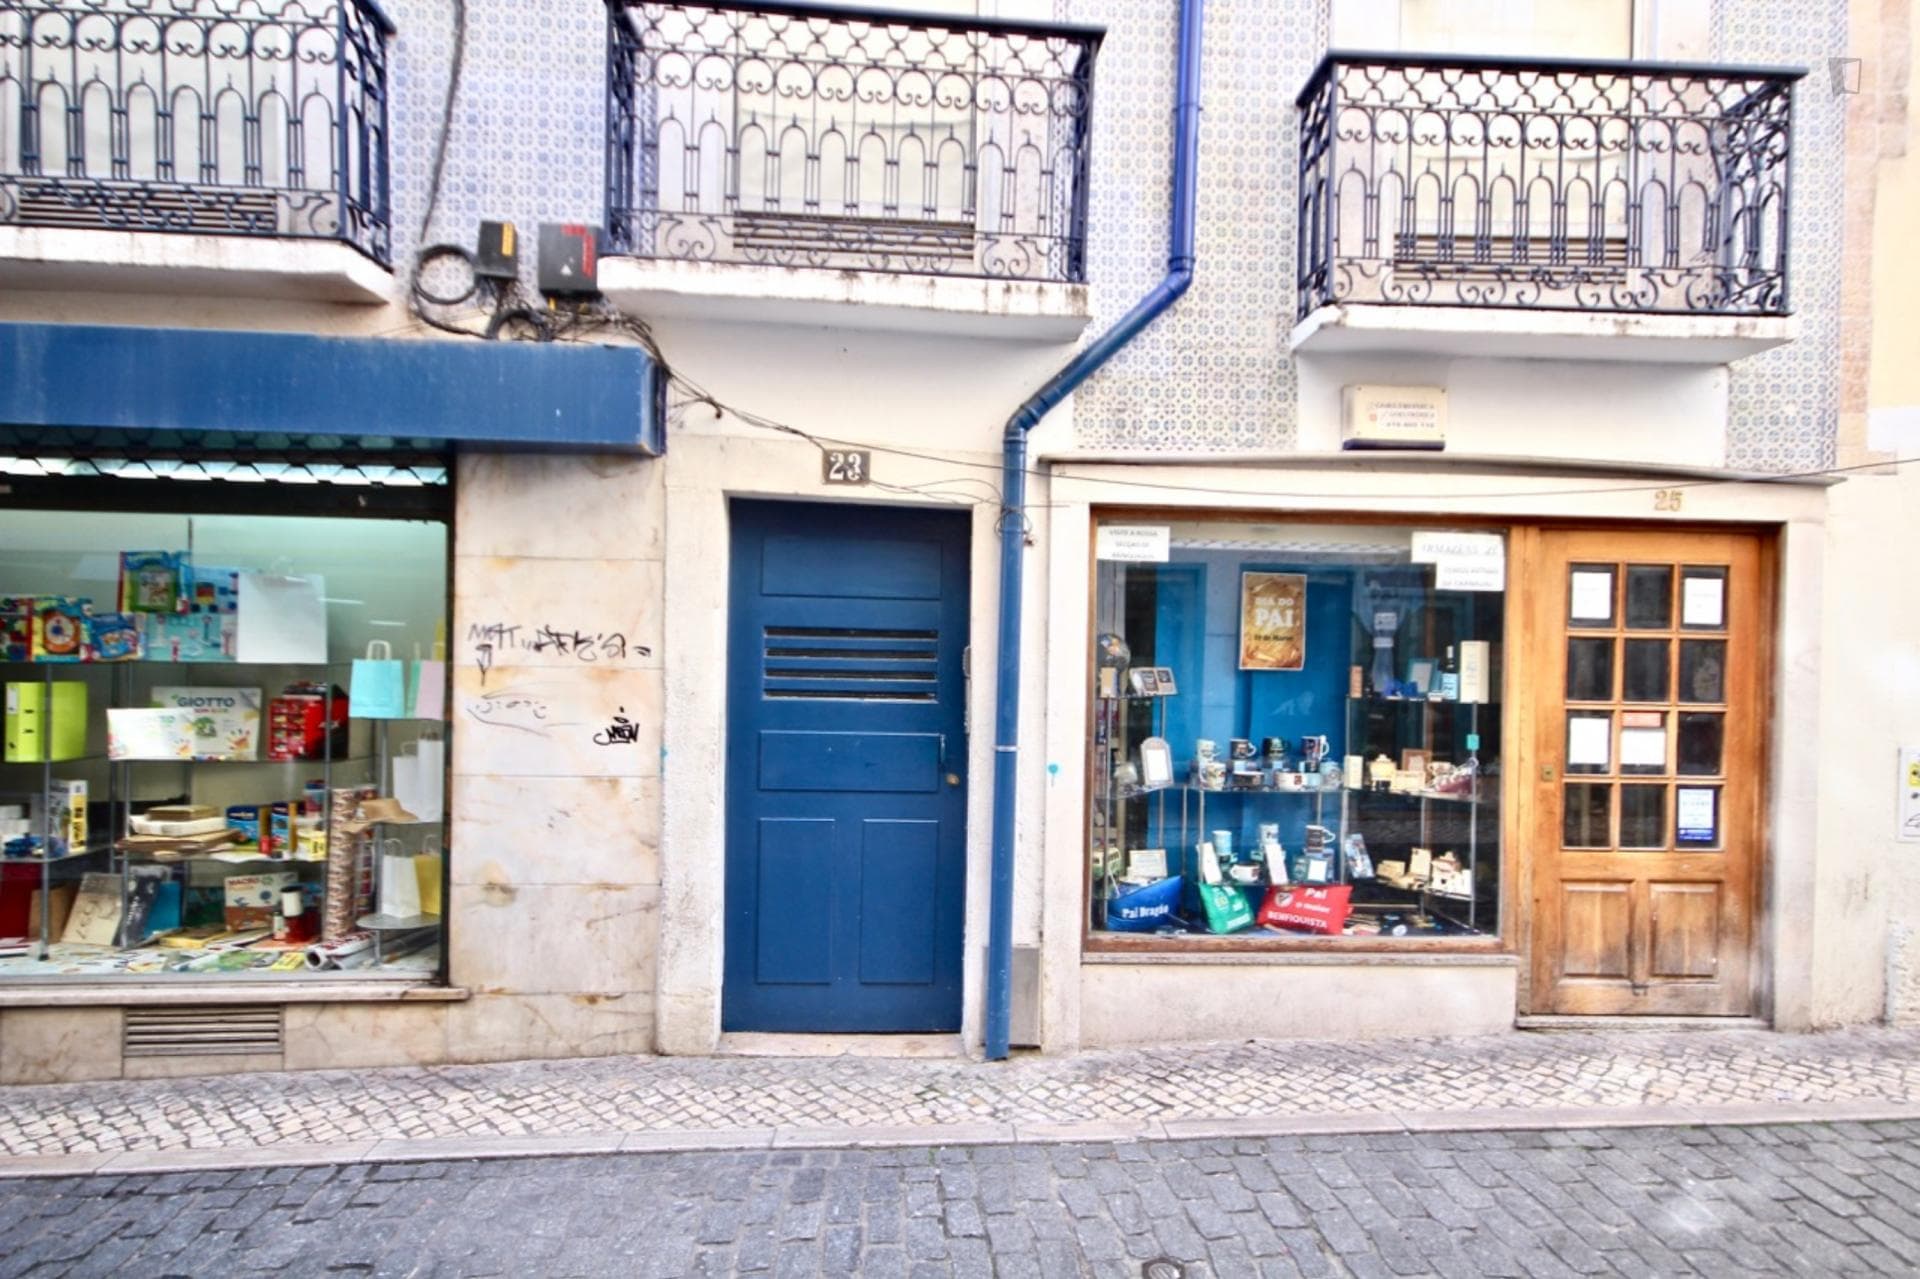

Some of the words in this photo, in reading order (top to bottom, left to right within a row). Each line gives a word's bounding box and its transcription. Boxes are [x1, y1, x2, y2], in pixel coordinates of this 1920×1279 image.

[828, 452, 863, 481] 23
[1654, 489, 1683, 512] 25
[1278, 597, 1294, 606] DO
[1254, 608, 1294, 627] PAI
[177, 696, 236, 708] GIOTTO
[1304, 887, 1328, 900] Pai
